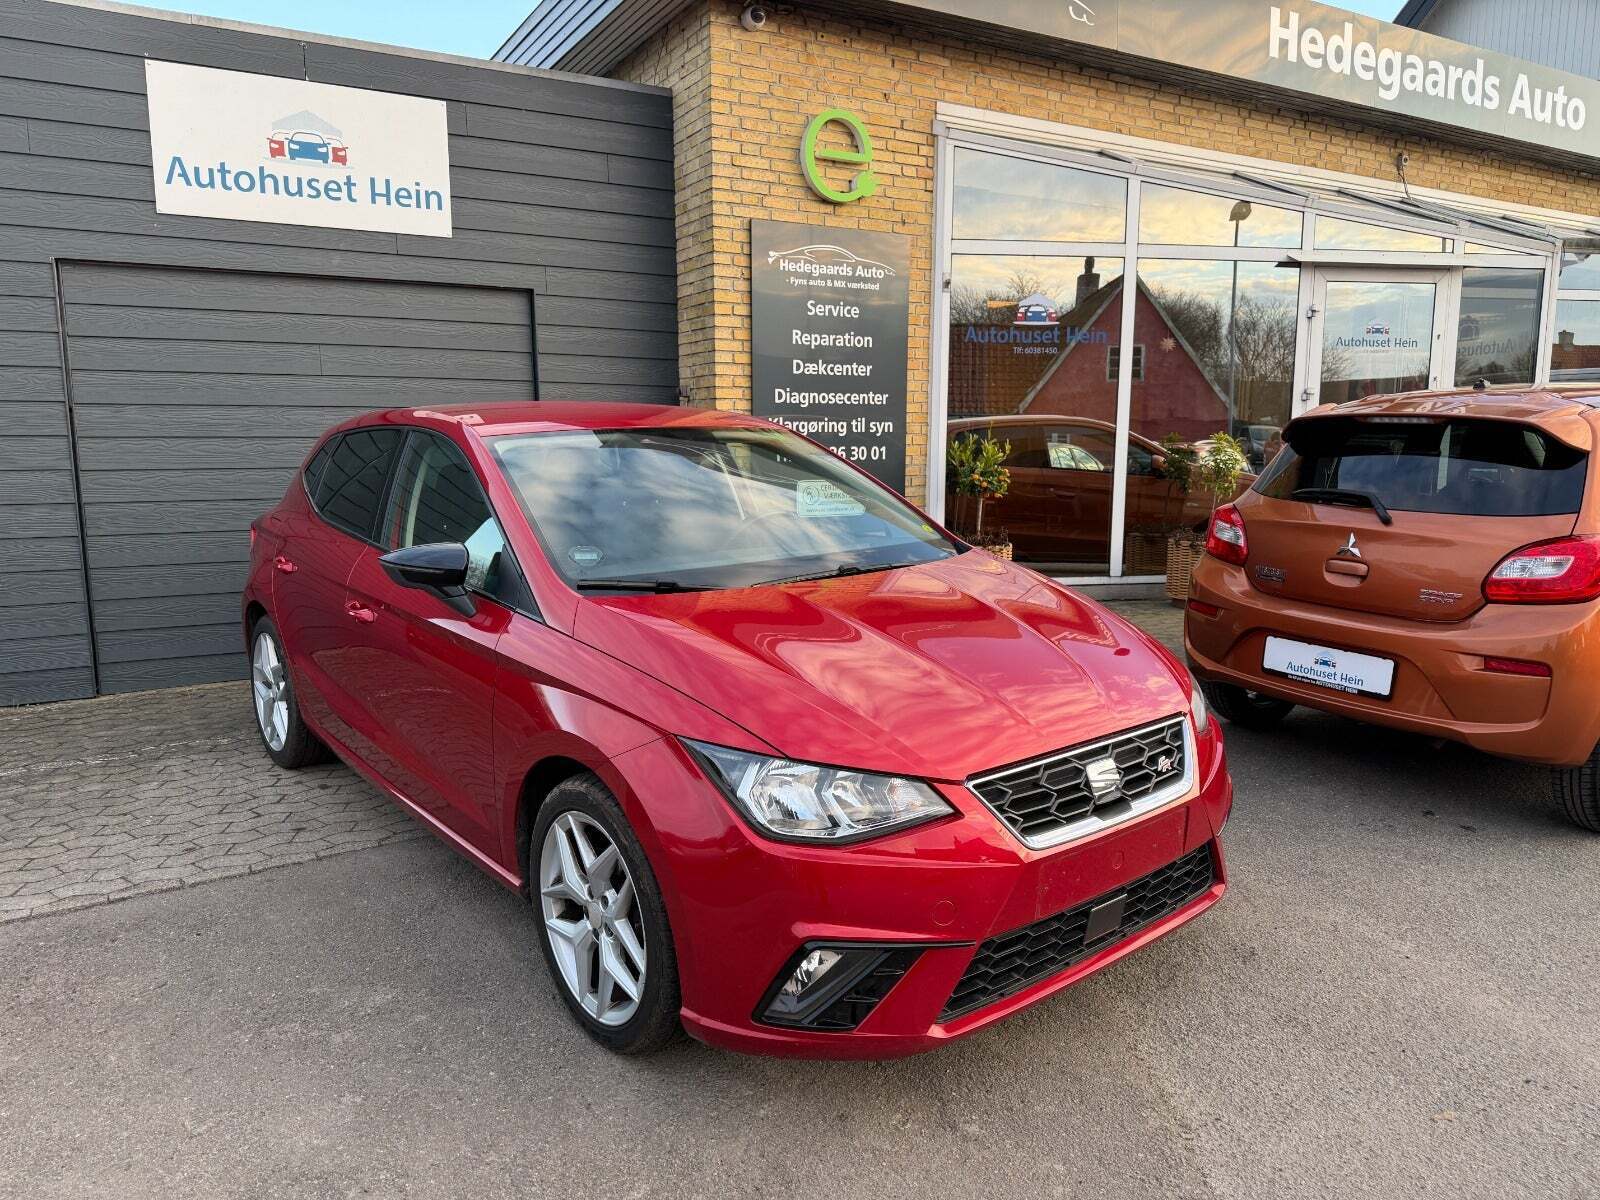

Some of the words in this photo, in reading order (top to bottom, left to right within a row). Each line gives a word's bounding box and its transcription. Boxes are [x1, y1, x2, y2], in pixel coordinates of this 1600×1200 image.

[1268, 6, 1500, 110] Hedegaards
[1507, 73, 1586, 131] Auto
[165, 155, 357, 202] Autohuset
[369, 176, 443, 211] Hein
[779, 258, 852, 277] Hedegaards
[855, 265, 885, 279] Auto
[790, 276, 807, 287] Fyns
[808, 278, 826, 287] auto
[826, 279, 832, 287] &
[833, 280, 846, 288] MX
[847, 280, 880, 290] værksted
[806, 299, 860, 318] Service
[792, 328, 873, 350] Reparation
[965, 323, 1060, 344] Autohuset
[1066, 326, 1107, 344] Hein
[1336, 336, 1391, 348] Autohuset
[1394, 337, 1418, 348] Hein
[792, 359, 873, 377] Dækcenter
[774, 387, 889, 408] Diagnosecenter
[850, 417, 866, 433] til
[869, 421, 894, 437] syn
[850, 446, 868, 461] 30
[870, 446, 886, 460] 01
[1286, 661, 1338, 681] Autohuset
[1340, 672, 1364, 687] Hein
